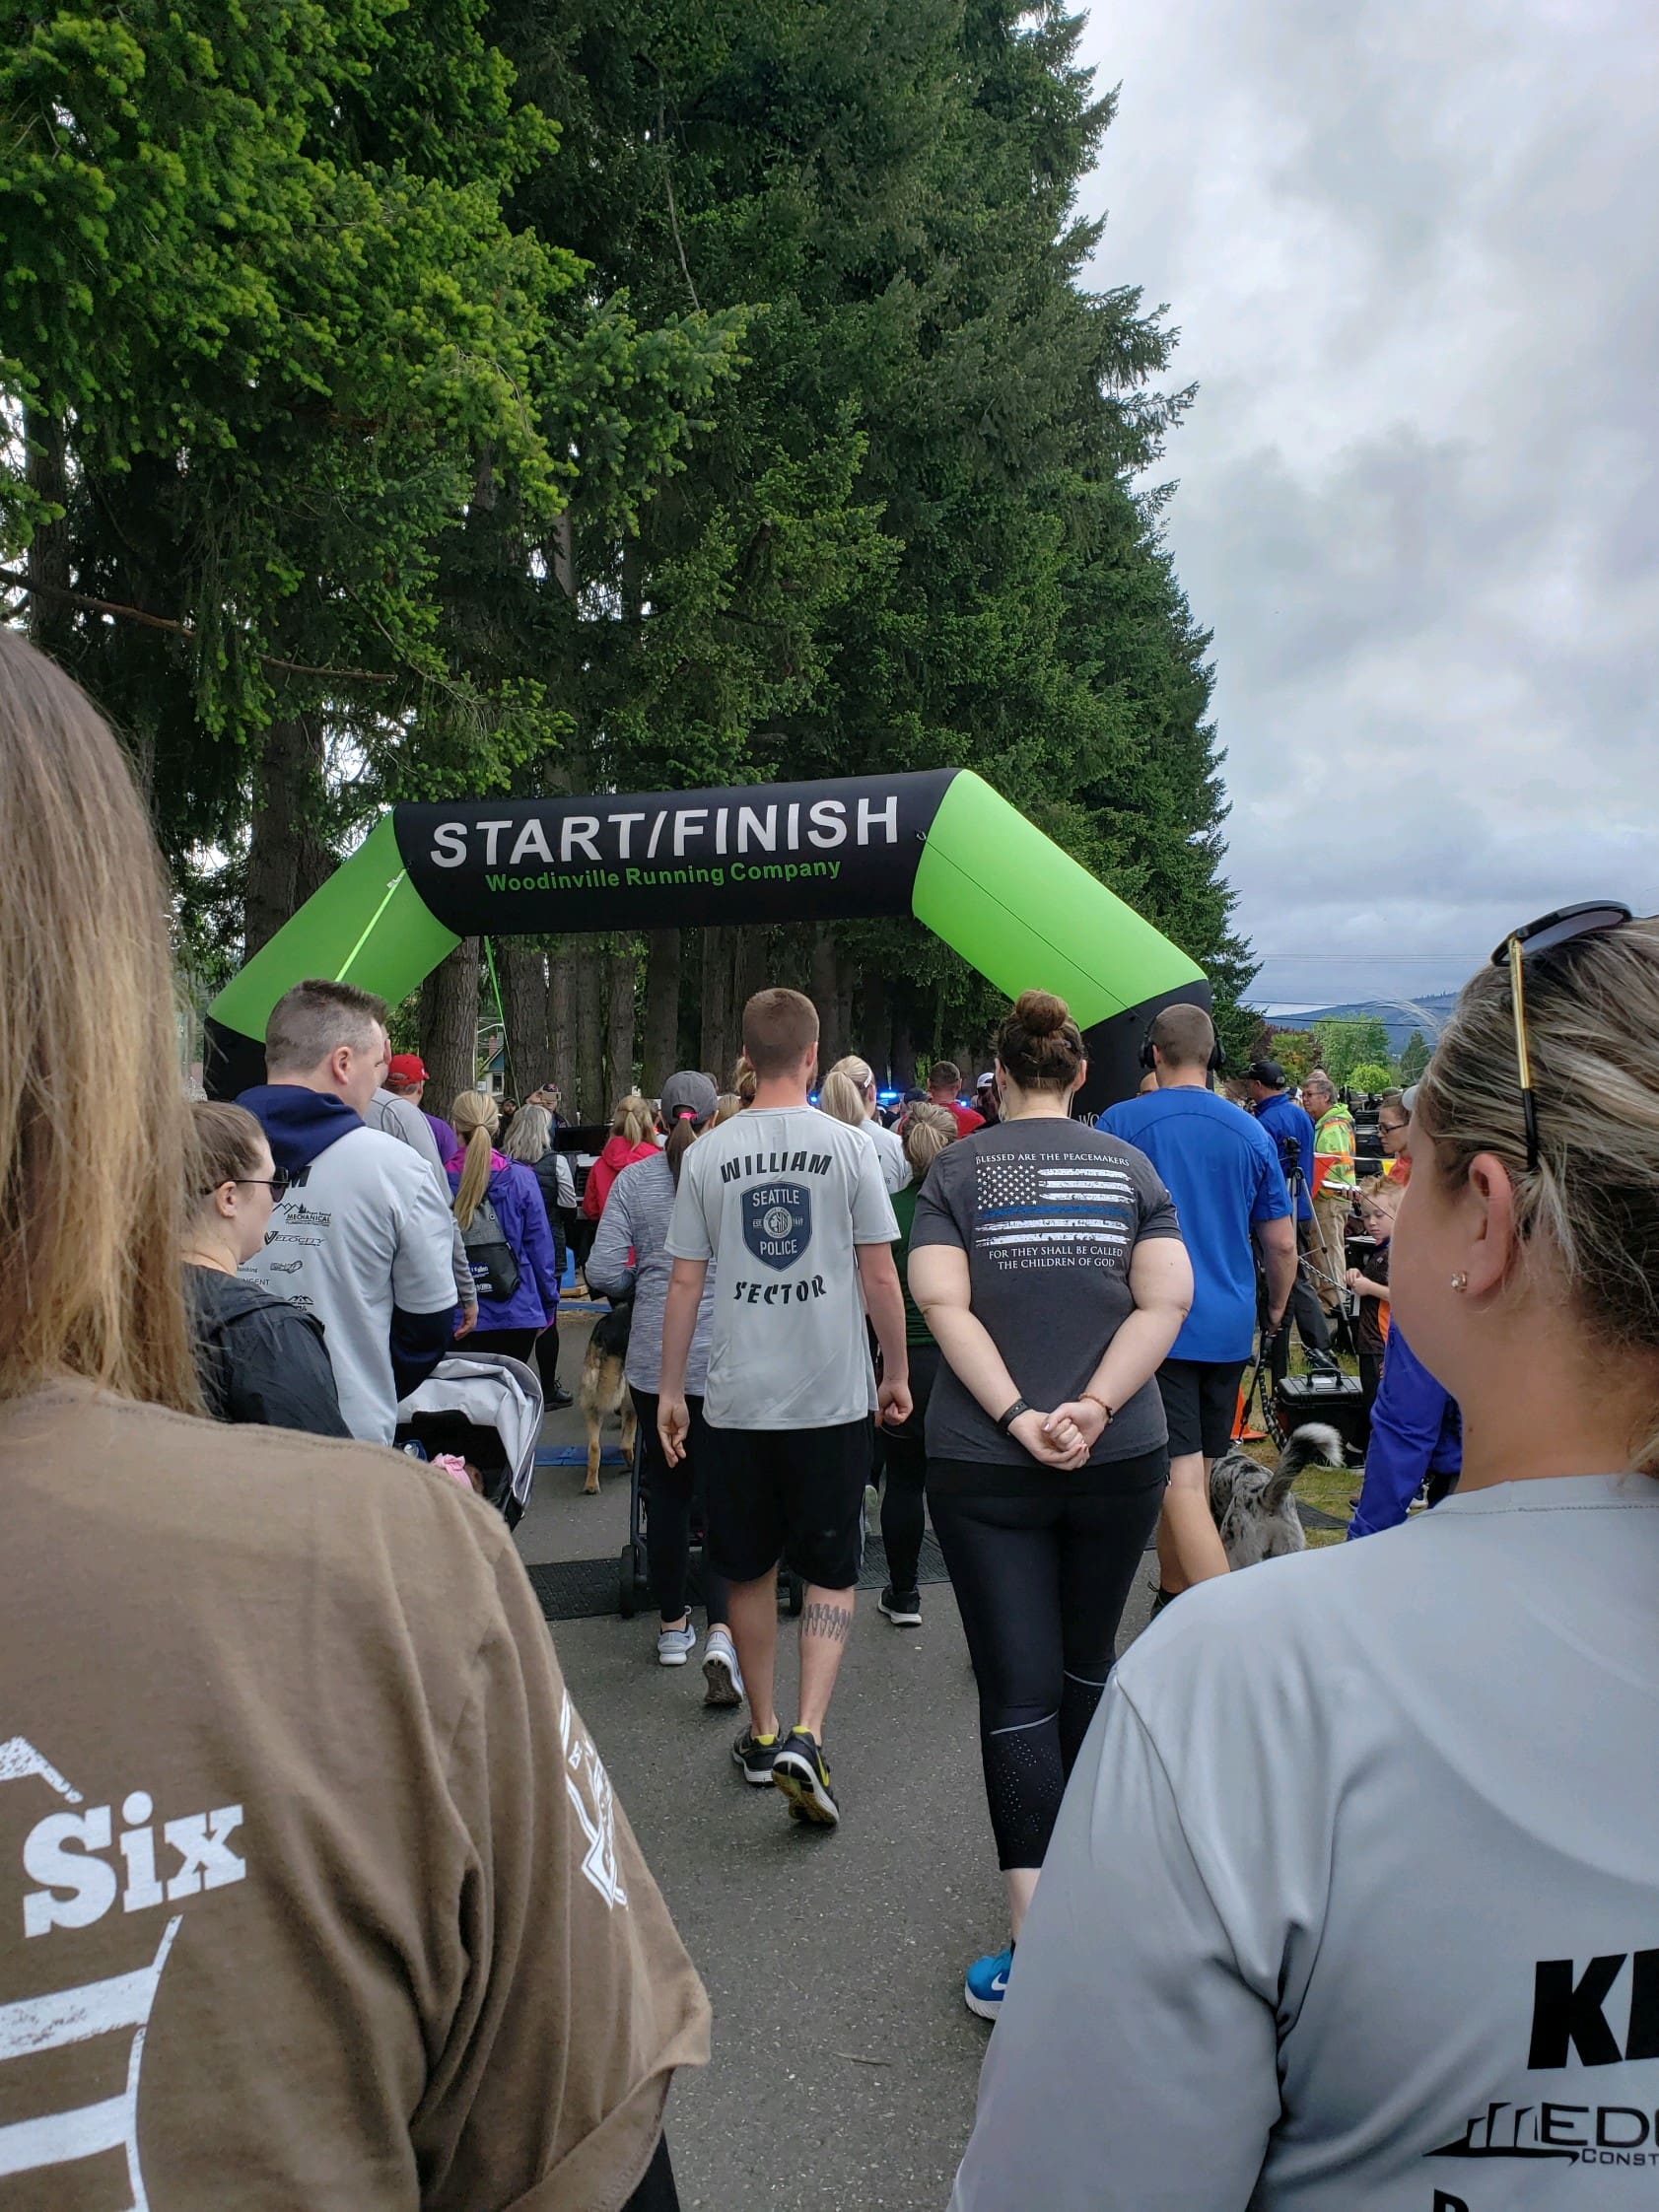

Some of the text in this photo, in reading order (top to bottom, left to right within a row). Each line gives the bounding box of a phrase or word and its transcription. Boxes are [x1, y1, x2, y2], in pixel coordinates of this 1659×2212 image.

[430, 795, 899, 868] START/FINISH
[485, 859, 841, 892] Woodinville Running Company
[721, 1151, 833, 1183] WILLIAM
[976, 1153, 1014, 1165] BLESSED
[1064, 1153, 1130, 1167] PEACEMAKERS
[752, 1189, 799, 1208] SEATTLE
[286, 1213, 330, 1222] MECHANICAL
[760, 1238, 797, 1256] POLICE
[989, 1246, 1123, 1260] FOR THEY SHALL BE CALLED
[998, 1258, 1115, 1270] THE CHILDREN OF GOD
[733, 1275, 827, 1305] SECTOR
[23, 1789, 246, 1938] Six
[1541, 2102, 1659, 2148] ED
